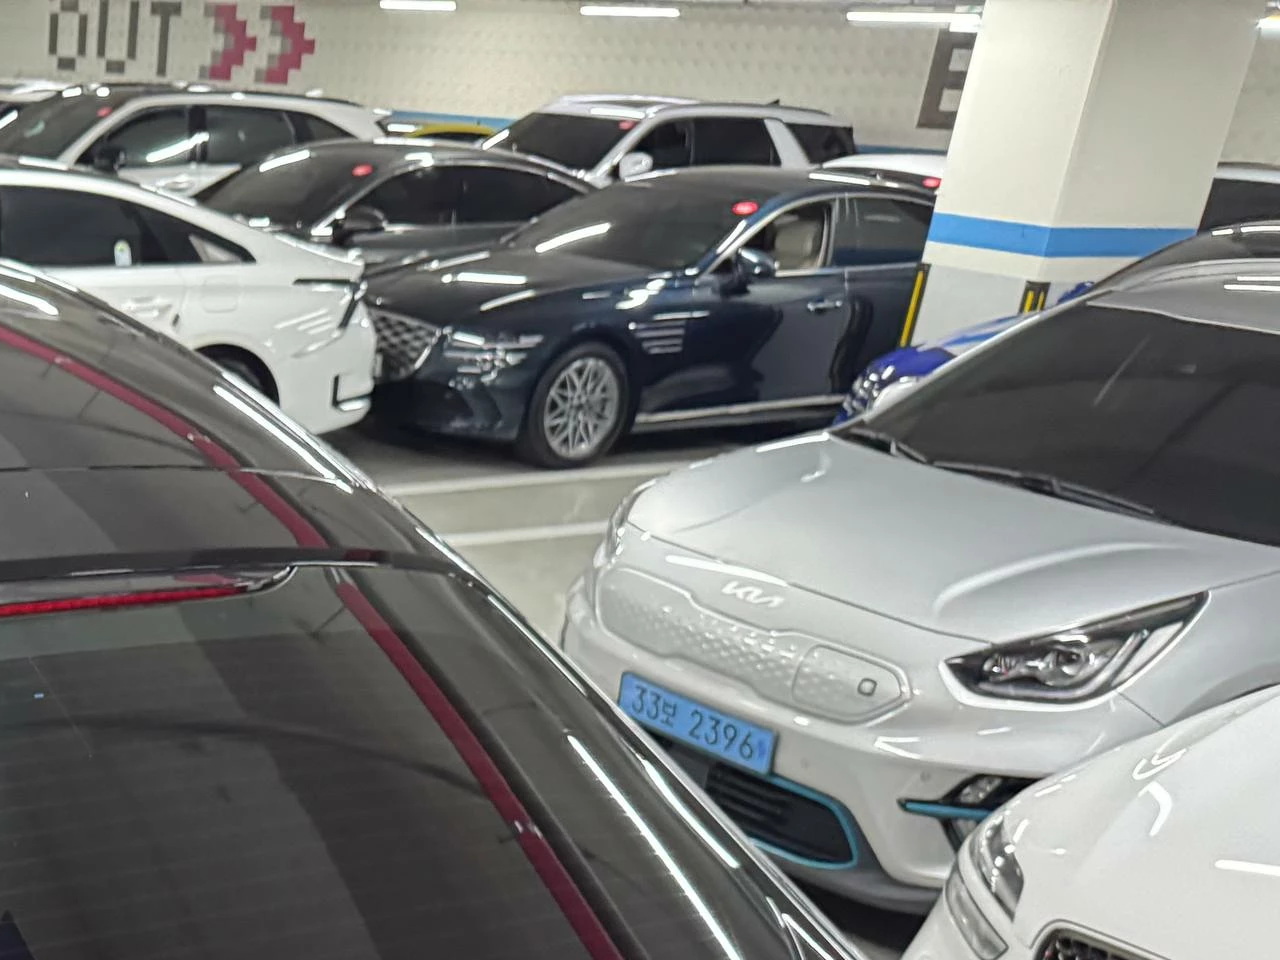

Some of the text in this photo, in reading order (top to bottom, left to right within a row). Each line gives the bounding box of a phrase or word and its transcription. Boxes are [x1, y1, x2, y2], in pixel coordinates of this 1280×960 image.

[48, 0, 182, 77] OUT
[721, 580, 785, 608] KIA
[688, 709, 754, 761] 2396
